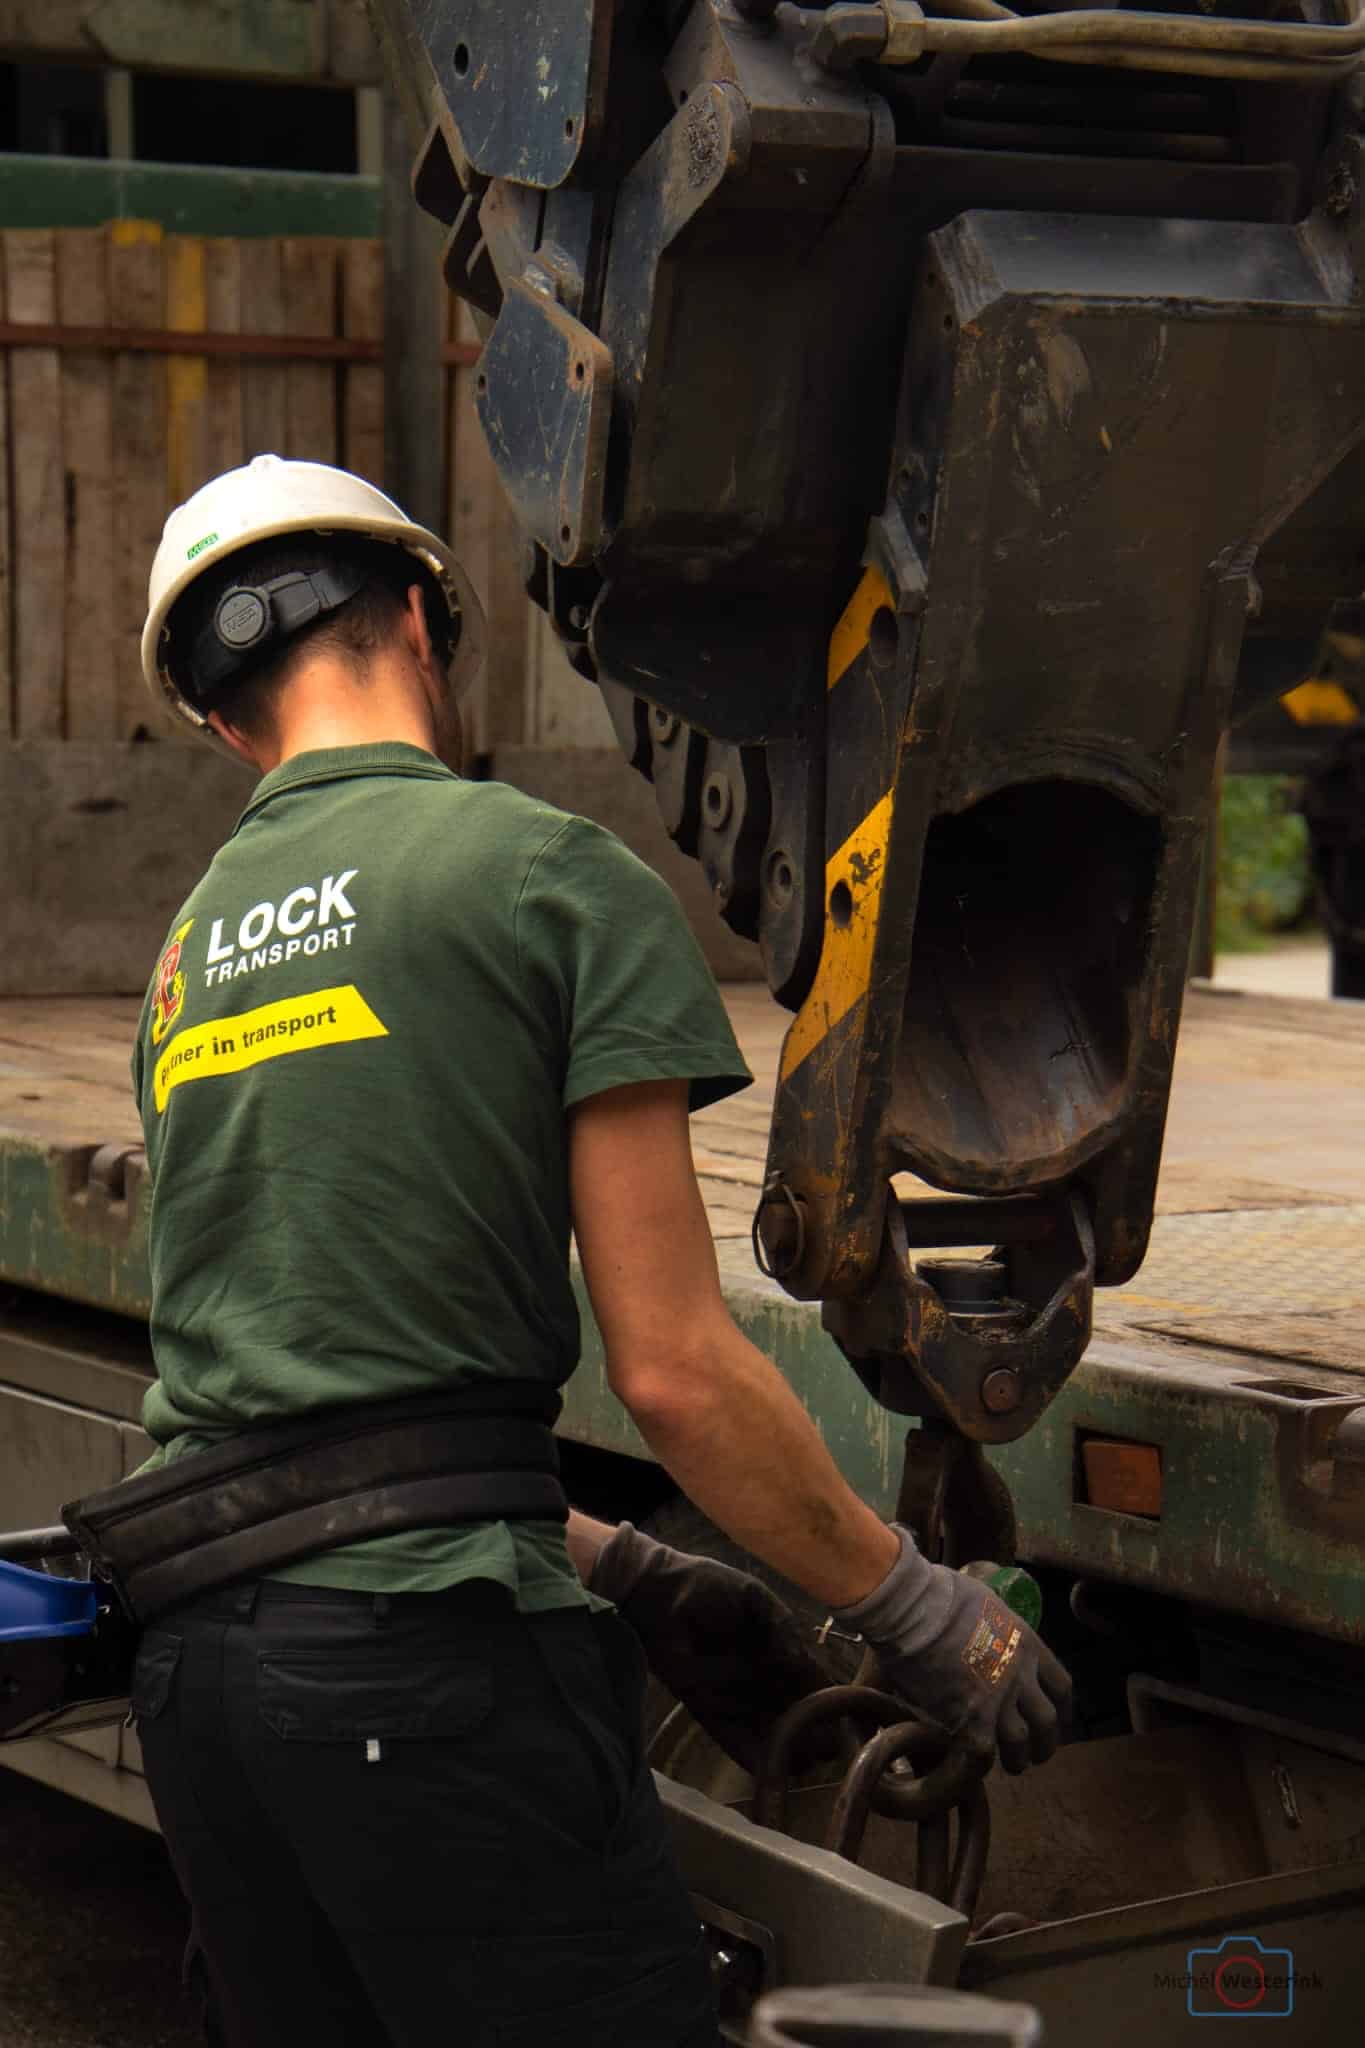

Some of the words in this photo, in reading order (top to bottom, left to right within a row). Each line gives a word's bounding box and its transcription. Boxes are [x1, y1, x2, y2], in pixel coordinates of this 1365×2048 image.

[207, 869, 359, 965] LOCK
[204, 923, 357, 987] TRANSPORT
[212, 1036, 235, 1057] in
[243, 1005, 337, 1048] transport
